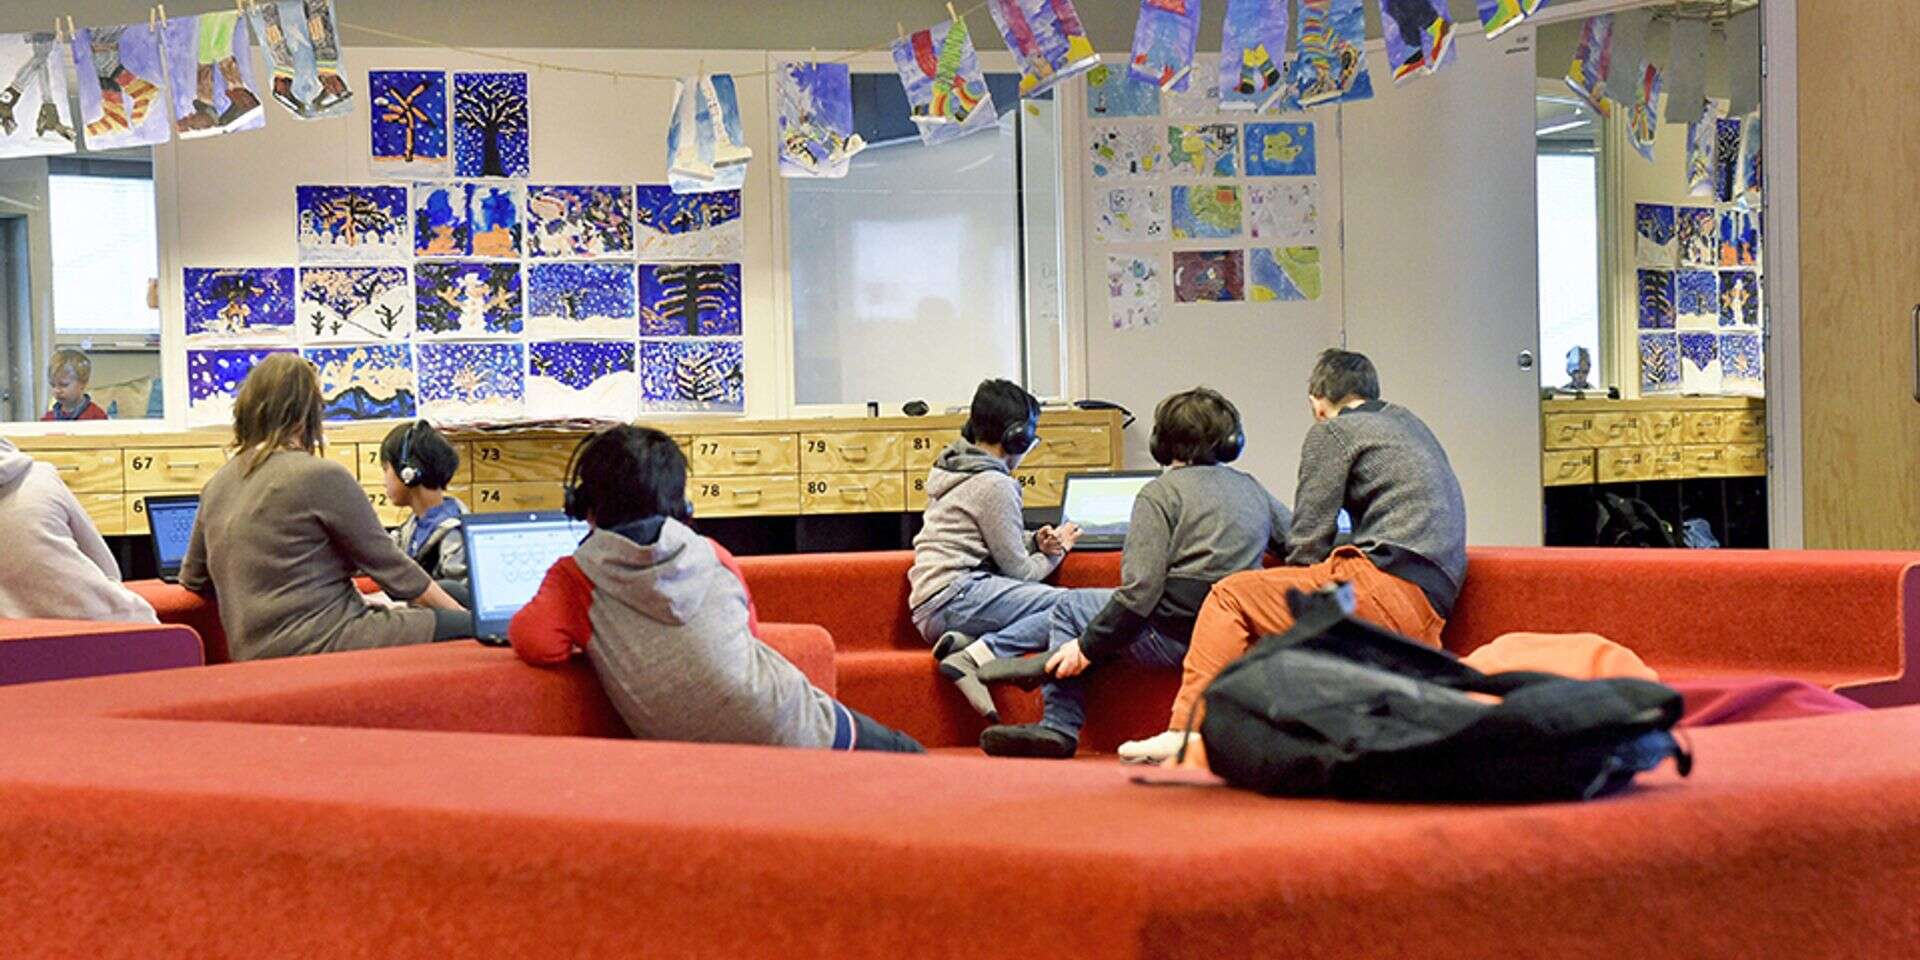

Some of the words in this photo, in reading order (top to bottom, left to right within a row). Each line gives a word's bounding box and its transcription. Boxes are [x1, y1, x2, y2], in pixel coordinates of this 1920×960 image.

[701, 444, 718, 455] 77
[807, 440, 826, 452] 79
[913, 438, 931, 449] 81
[369, 452, 377, 463] 7
[481, 448, 500, 460] 73
[132, 456, 153, 470] 67
[702, 484, 720, 496] 78
[808, 482, 827, 494] 80
[914, 479, 924, 490] 8
[481, 490, 500, 502] 74
[134, 500, 143, 513] 6
